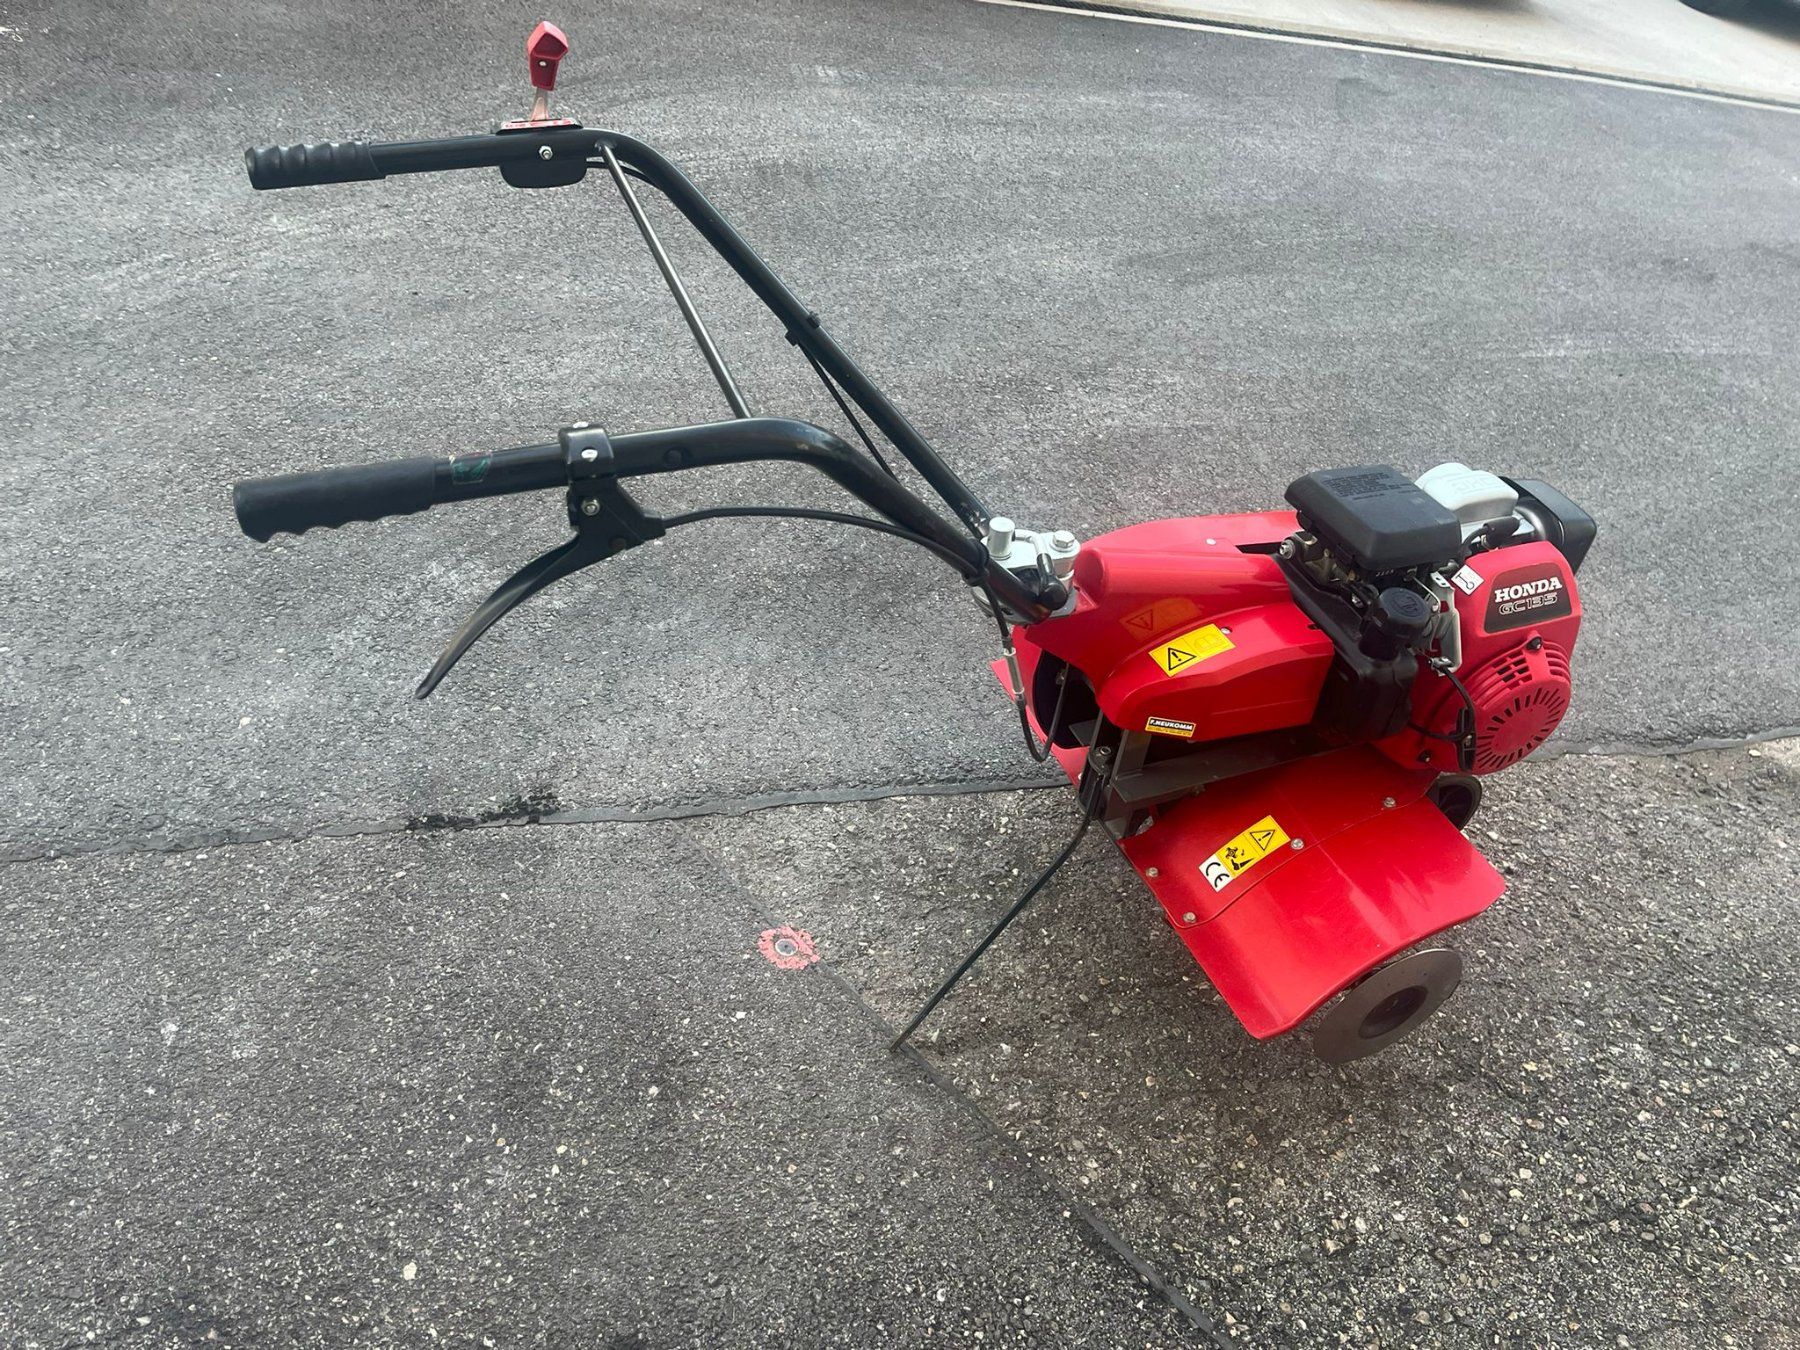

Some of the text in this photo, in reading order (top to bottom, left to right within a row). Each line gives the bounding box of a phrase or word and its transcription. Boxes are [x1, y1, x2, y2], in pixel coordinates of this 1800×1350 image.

[1494, 577, 1563, 603] HONDA
[1499, 592, 1558, 615] GC135
[1205, 861, 1230, 888] CE
